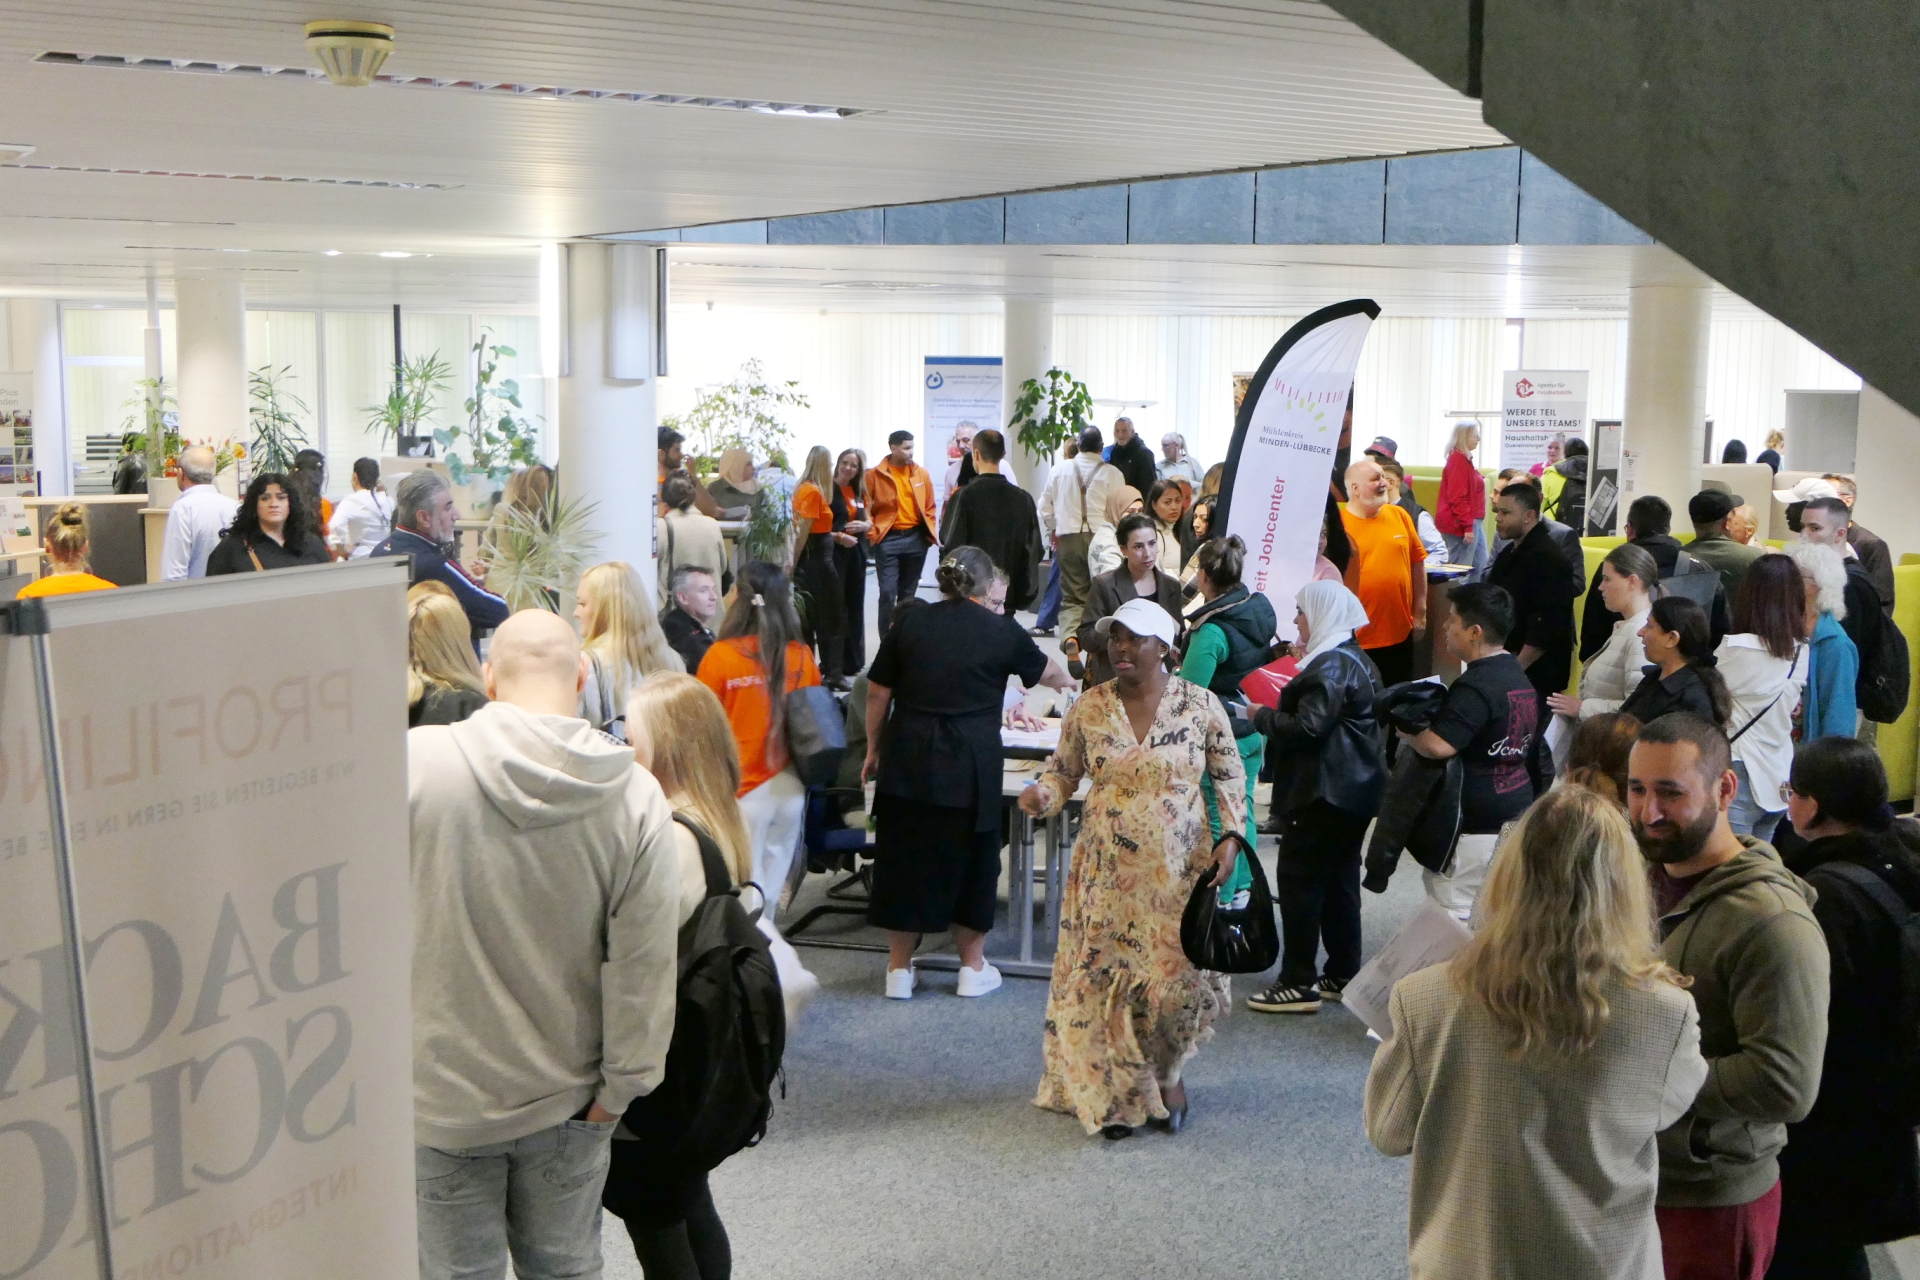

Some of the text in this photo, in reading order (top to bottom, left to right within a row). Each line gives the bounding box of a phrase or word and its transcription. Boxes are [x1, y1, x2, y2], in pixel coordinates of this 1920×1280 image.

[0, 388, 19, 396] Plus
[1506, 408, 1557, 416] WERDE TEIL
[1506, 419, 1581, 427] UNSERES TEAMS!
[1262, 425, 1304, 439] Mühlenkreis
[1258, 436, 1332, 456] MINDEN-LÜBBECKE
[1258, 475, 1286, 566] Jobcenter
[1149, 726, 1190, 749] LOVE
